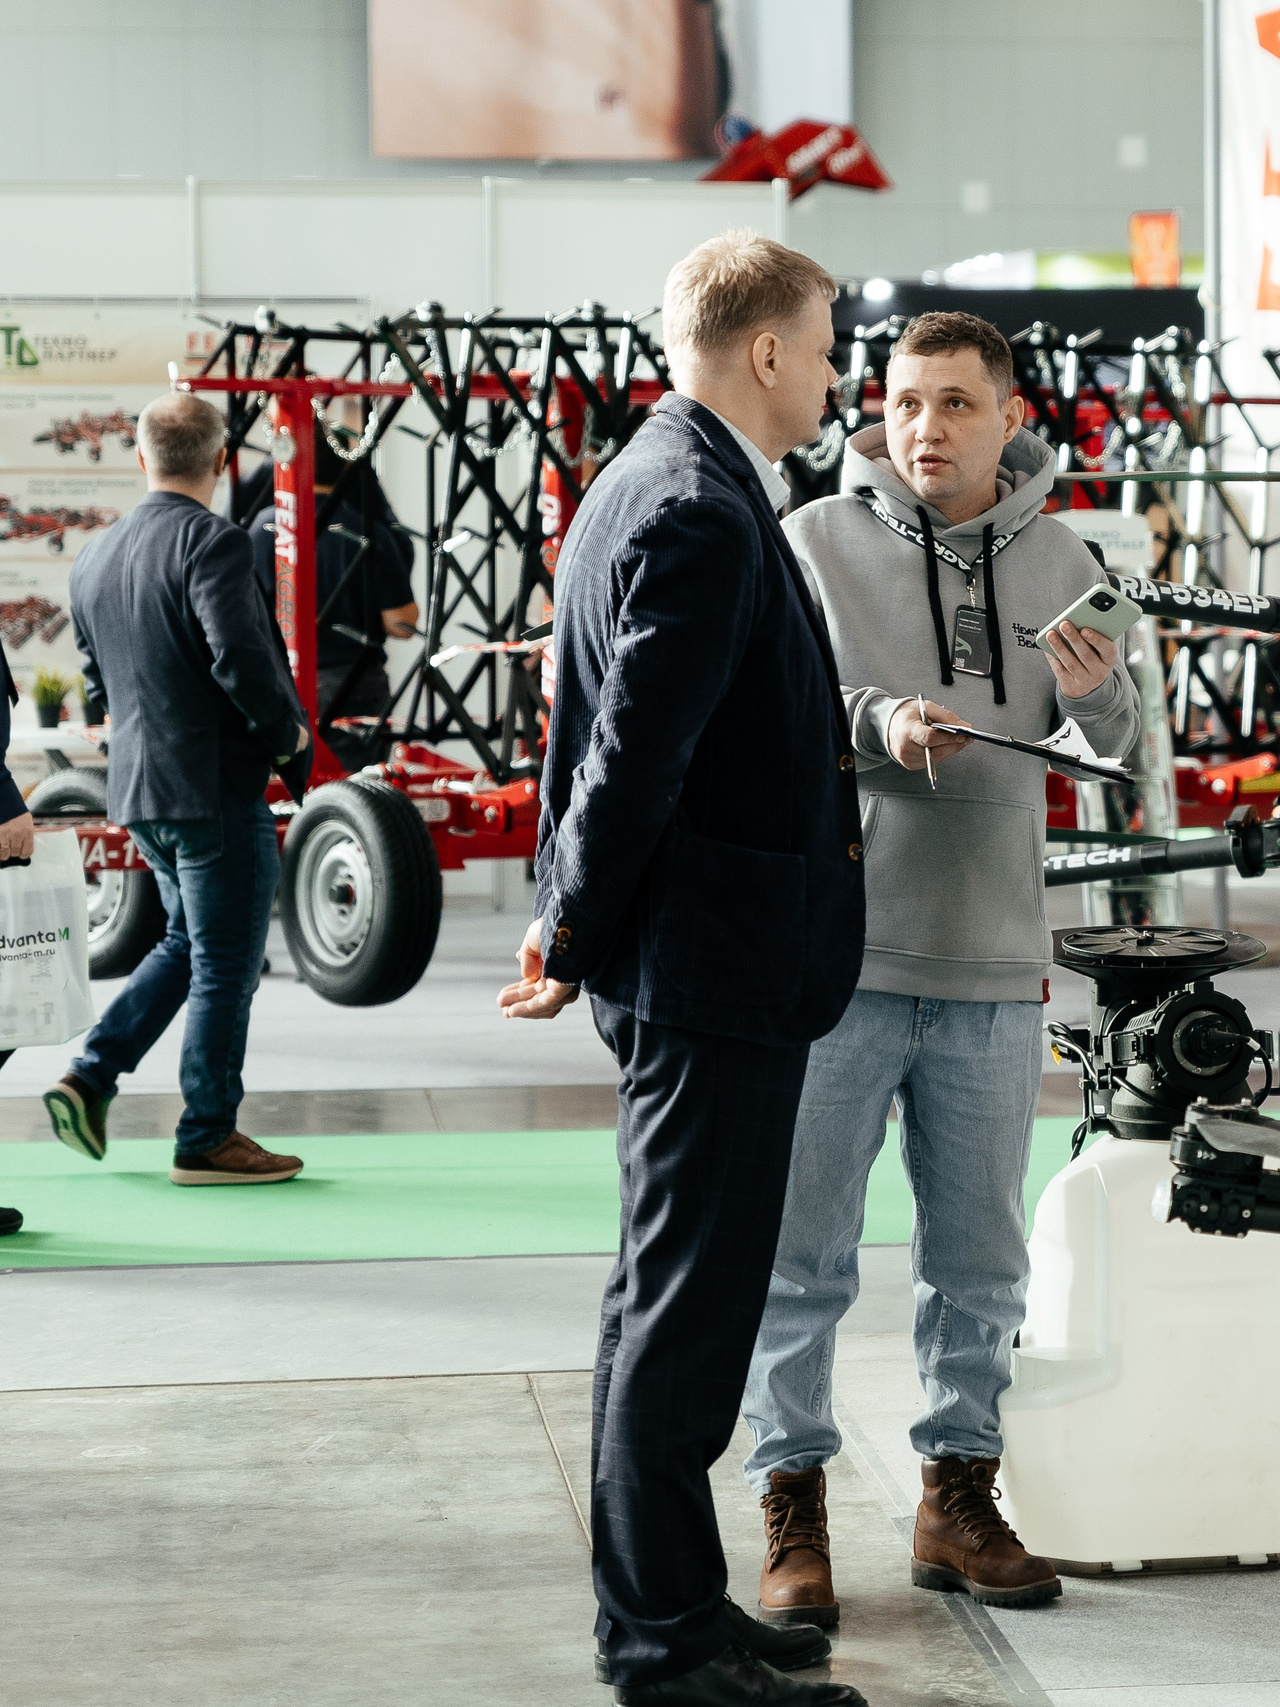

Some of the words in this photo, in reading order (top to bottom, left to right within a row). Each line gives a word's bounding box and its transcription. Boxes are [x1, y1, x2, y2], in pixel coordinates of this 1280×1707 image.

[274, 489, 298, 566] FEAT
[275, 559, 296, 639] AGRO
[1117, 575, 1271, 615] RA-534EP
